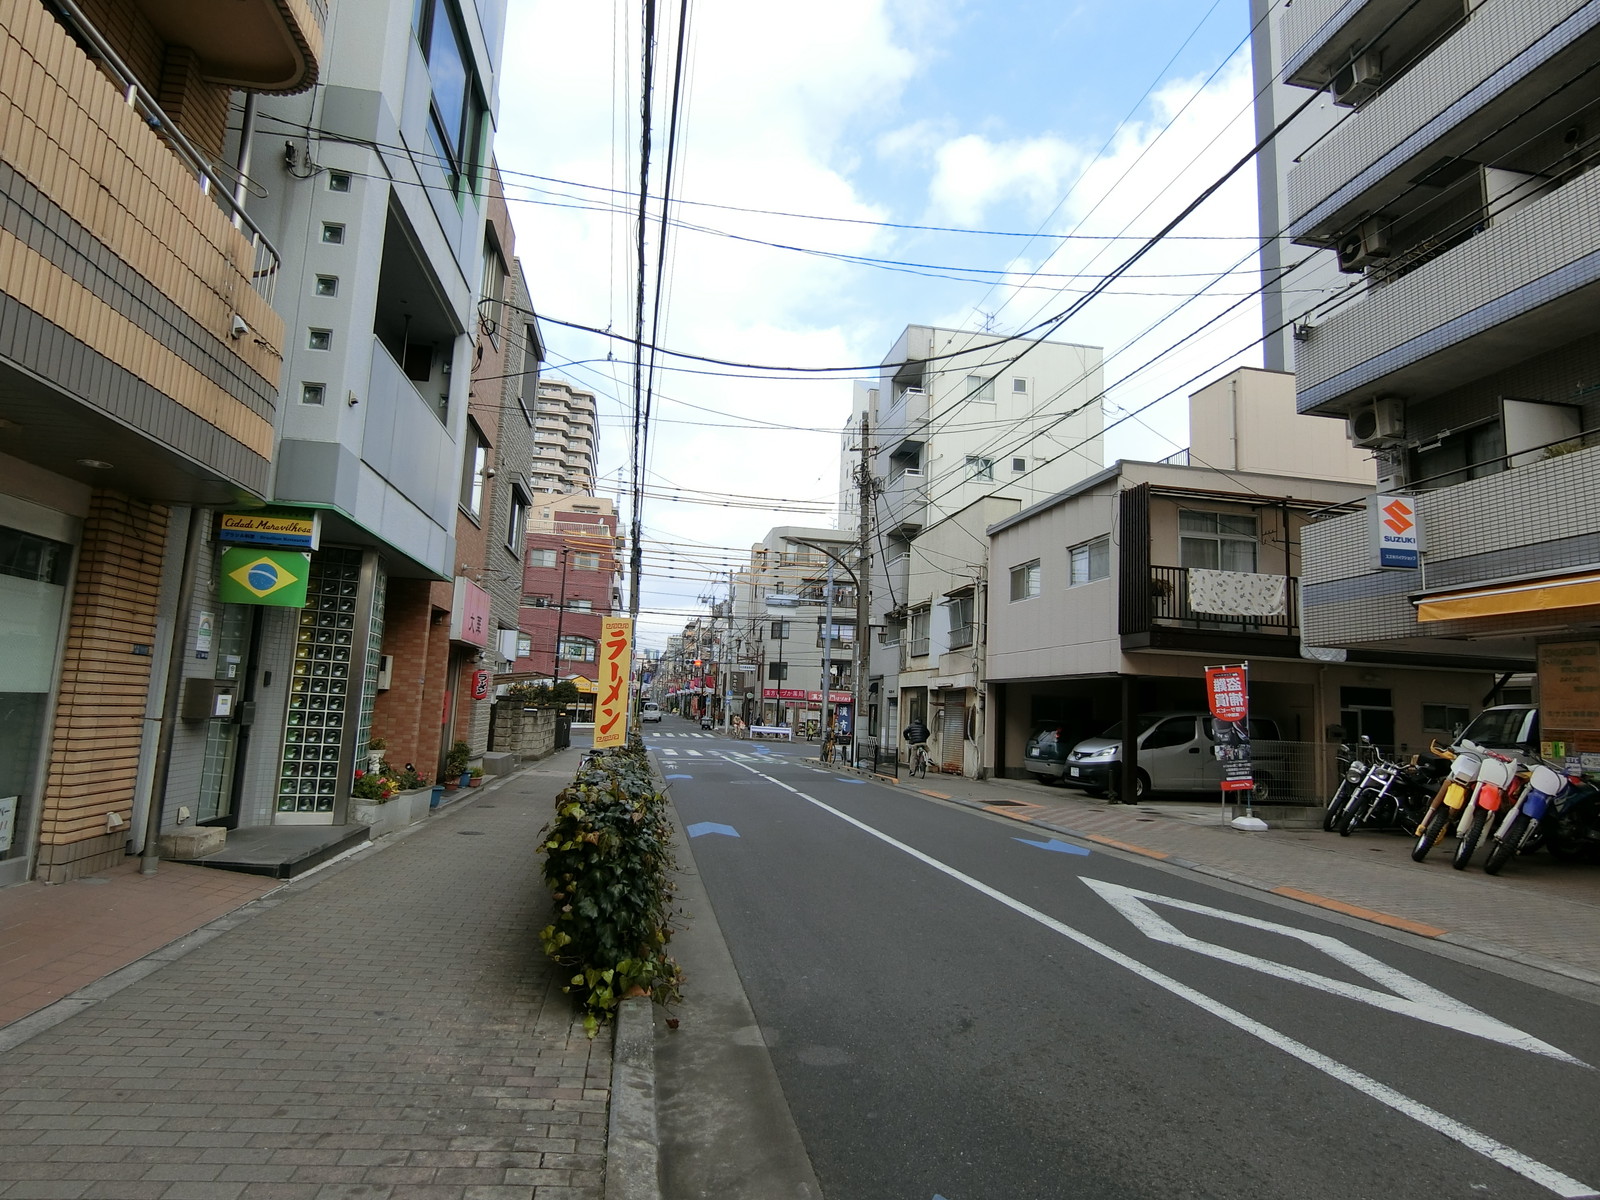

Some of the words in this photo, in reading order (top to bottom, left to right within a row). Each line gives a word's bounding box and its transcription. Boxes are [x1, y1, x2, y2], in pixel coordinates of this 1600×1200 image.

[224, 517, 254, 529] Cidade
[254, 520, 312, 534] Maravilhosa
[1384, 535, 1416, 544] SUZUKI
[476, 673, 488, 695] ラーメン
[599, 629, 628, 735] ラーメン
[839, 706, 848, 731] 漢方
